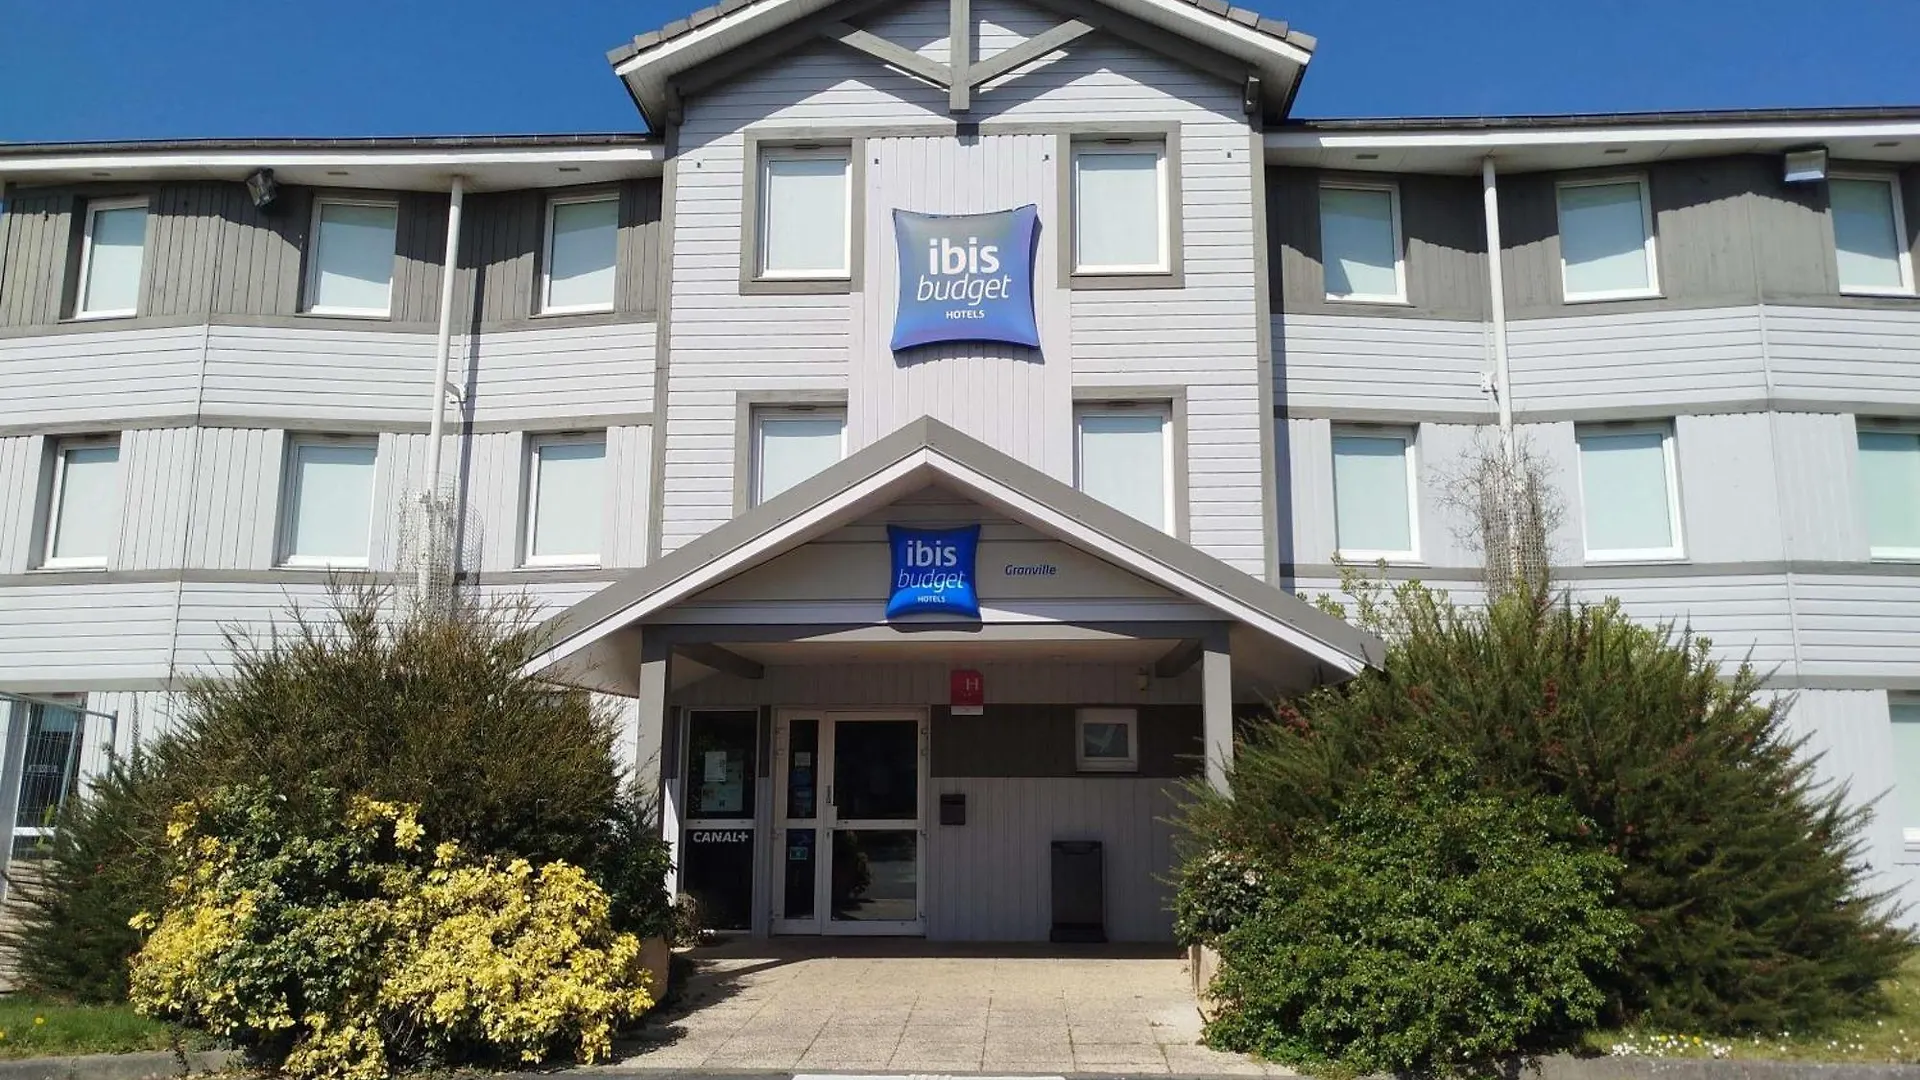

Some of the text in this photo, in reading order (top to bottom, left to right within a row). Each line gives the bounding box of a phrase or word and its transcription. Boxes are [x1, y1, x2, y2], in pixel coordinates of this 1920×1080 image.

[929, 237, 1000, 275] ibis
[917, 273, 1012, 306] budget
[945, 309, 985, 319] HOTELS
[907, 540, 957, 567] ibis
[1005, 564, 1057, 576] Granville
[897, 568, 965, 593] budget
[917, 595, 946, 603] HOTELS
[966, 678, 979, 691] H
[693, 832, 749, 843] CANAL+
